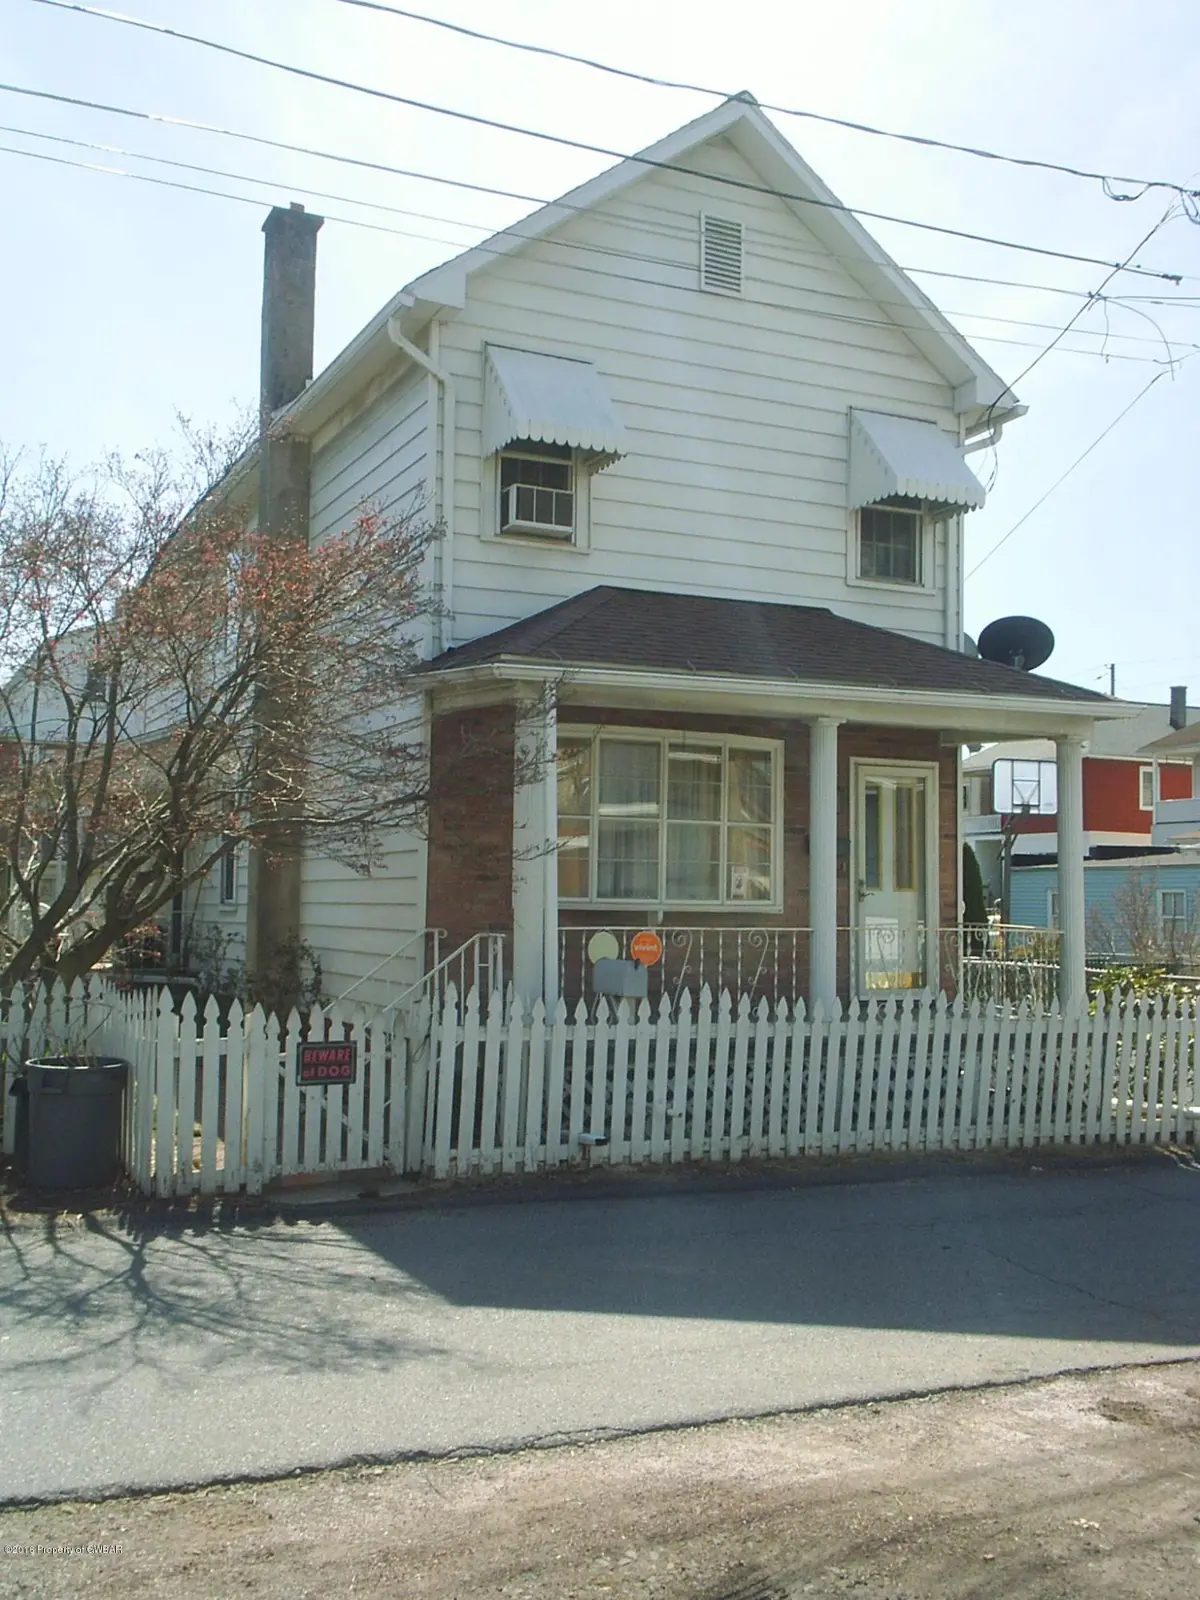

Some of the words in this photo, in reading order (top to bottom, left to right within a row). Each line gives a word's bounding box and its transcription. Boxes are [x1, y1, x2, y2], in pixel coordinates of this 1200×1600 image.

[303, 1048, 350, 1062] BEWARE
[303, 1067, 314, 1077] of
[318, 1065, 350, 1077] DOG
